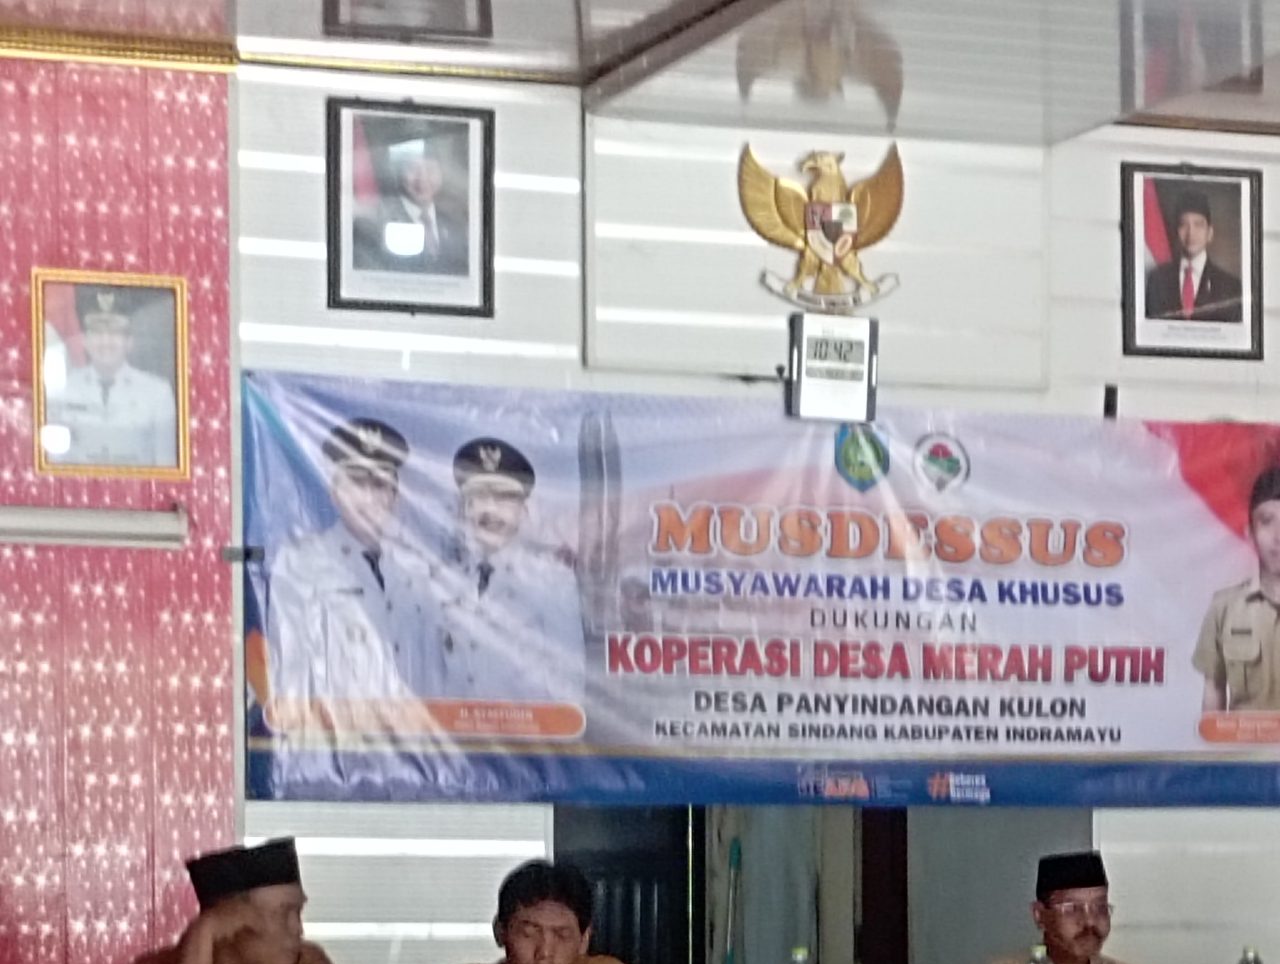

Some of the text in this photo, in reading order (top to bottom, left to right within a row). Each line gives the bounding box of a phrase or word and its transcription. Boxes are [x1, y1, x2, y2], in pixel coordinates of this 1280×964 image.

[651, 502, 1128, 568] MUSDESSUS
[652, 569, 1125, 607] MUSYAWARAH DESA KHUSUS
[810, 607, 977, 632] DUKUNGAN
[607, 634, 1165, 684] KOPERASI DESA MERAH PUTIH
[695, 690, 1087, 719] DESA PANYINDANGAN KULON
[655, 720, 1122, 743] KECAMATAN SINDANG KABUPATEN INDRAMAYU
